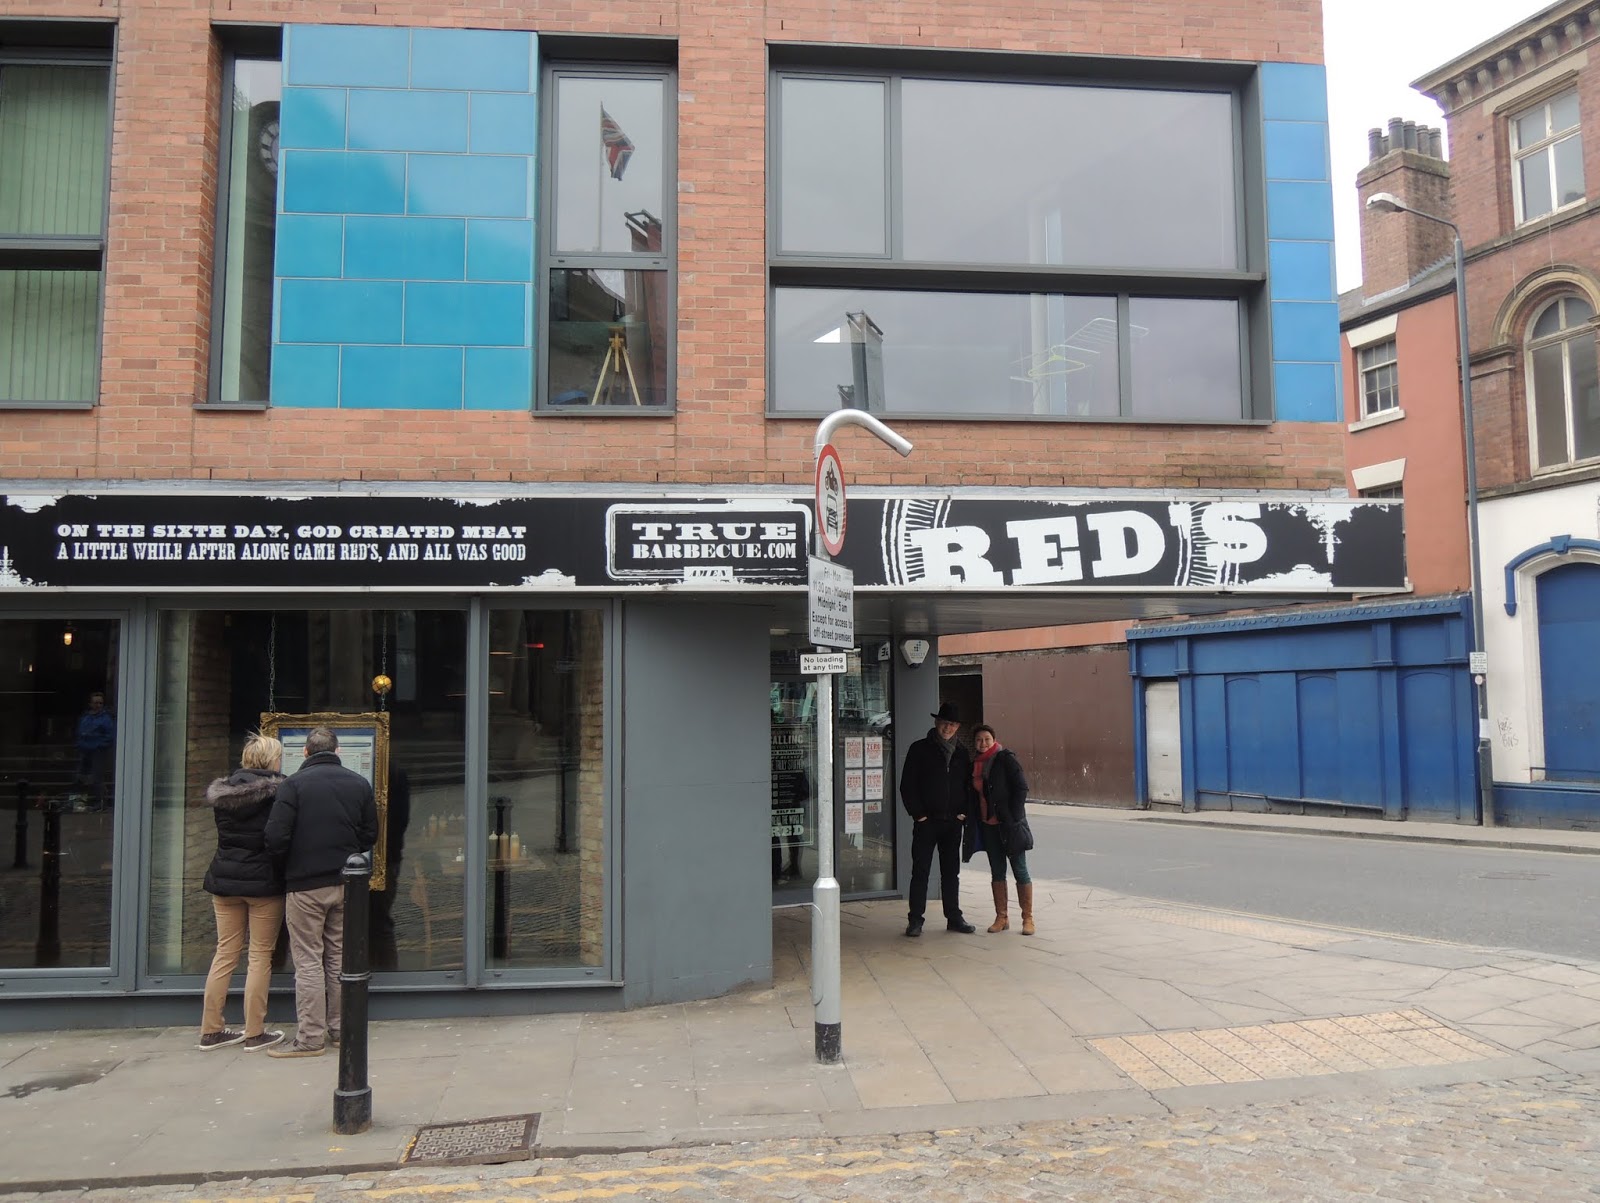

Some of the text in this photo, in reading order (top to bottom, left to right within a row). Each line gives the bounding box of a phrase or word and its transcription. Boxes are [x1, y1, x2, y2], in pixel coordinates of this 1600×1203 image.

[57, 524, 527, 541] ON THE SIXTH DAY, GOD CREATED MEAT
[632, 522, 797, 541] TRUE
[632, 542, 797, 559] BARBECUE.COM
[909, 501, 1268, 586] RED'S
[56, 542, 526, 563] A LITTLE WHILE AFTER ALONG CAME RED'S, AND ALL WAS GOOD
[818, 596, 836, 611] Midnight
[812, 611, 828, 625] Except
[834, 618, 848, 629] access
[813, 626, 852, 643] off-street premises
[771, 735, 803, 745] ALLING
